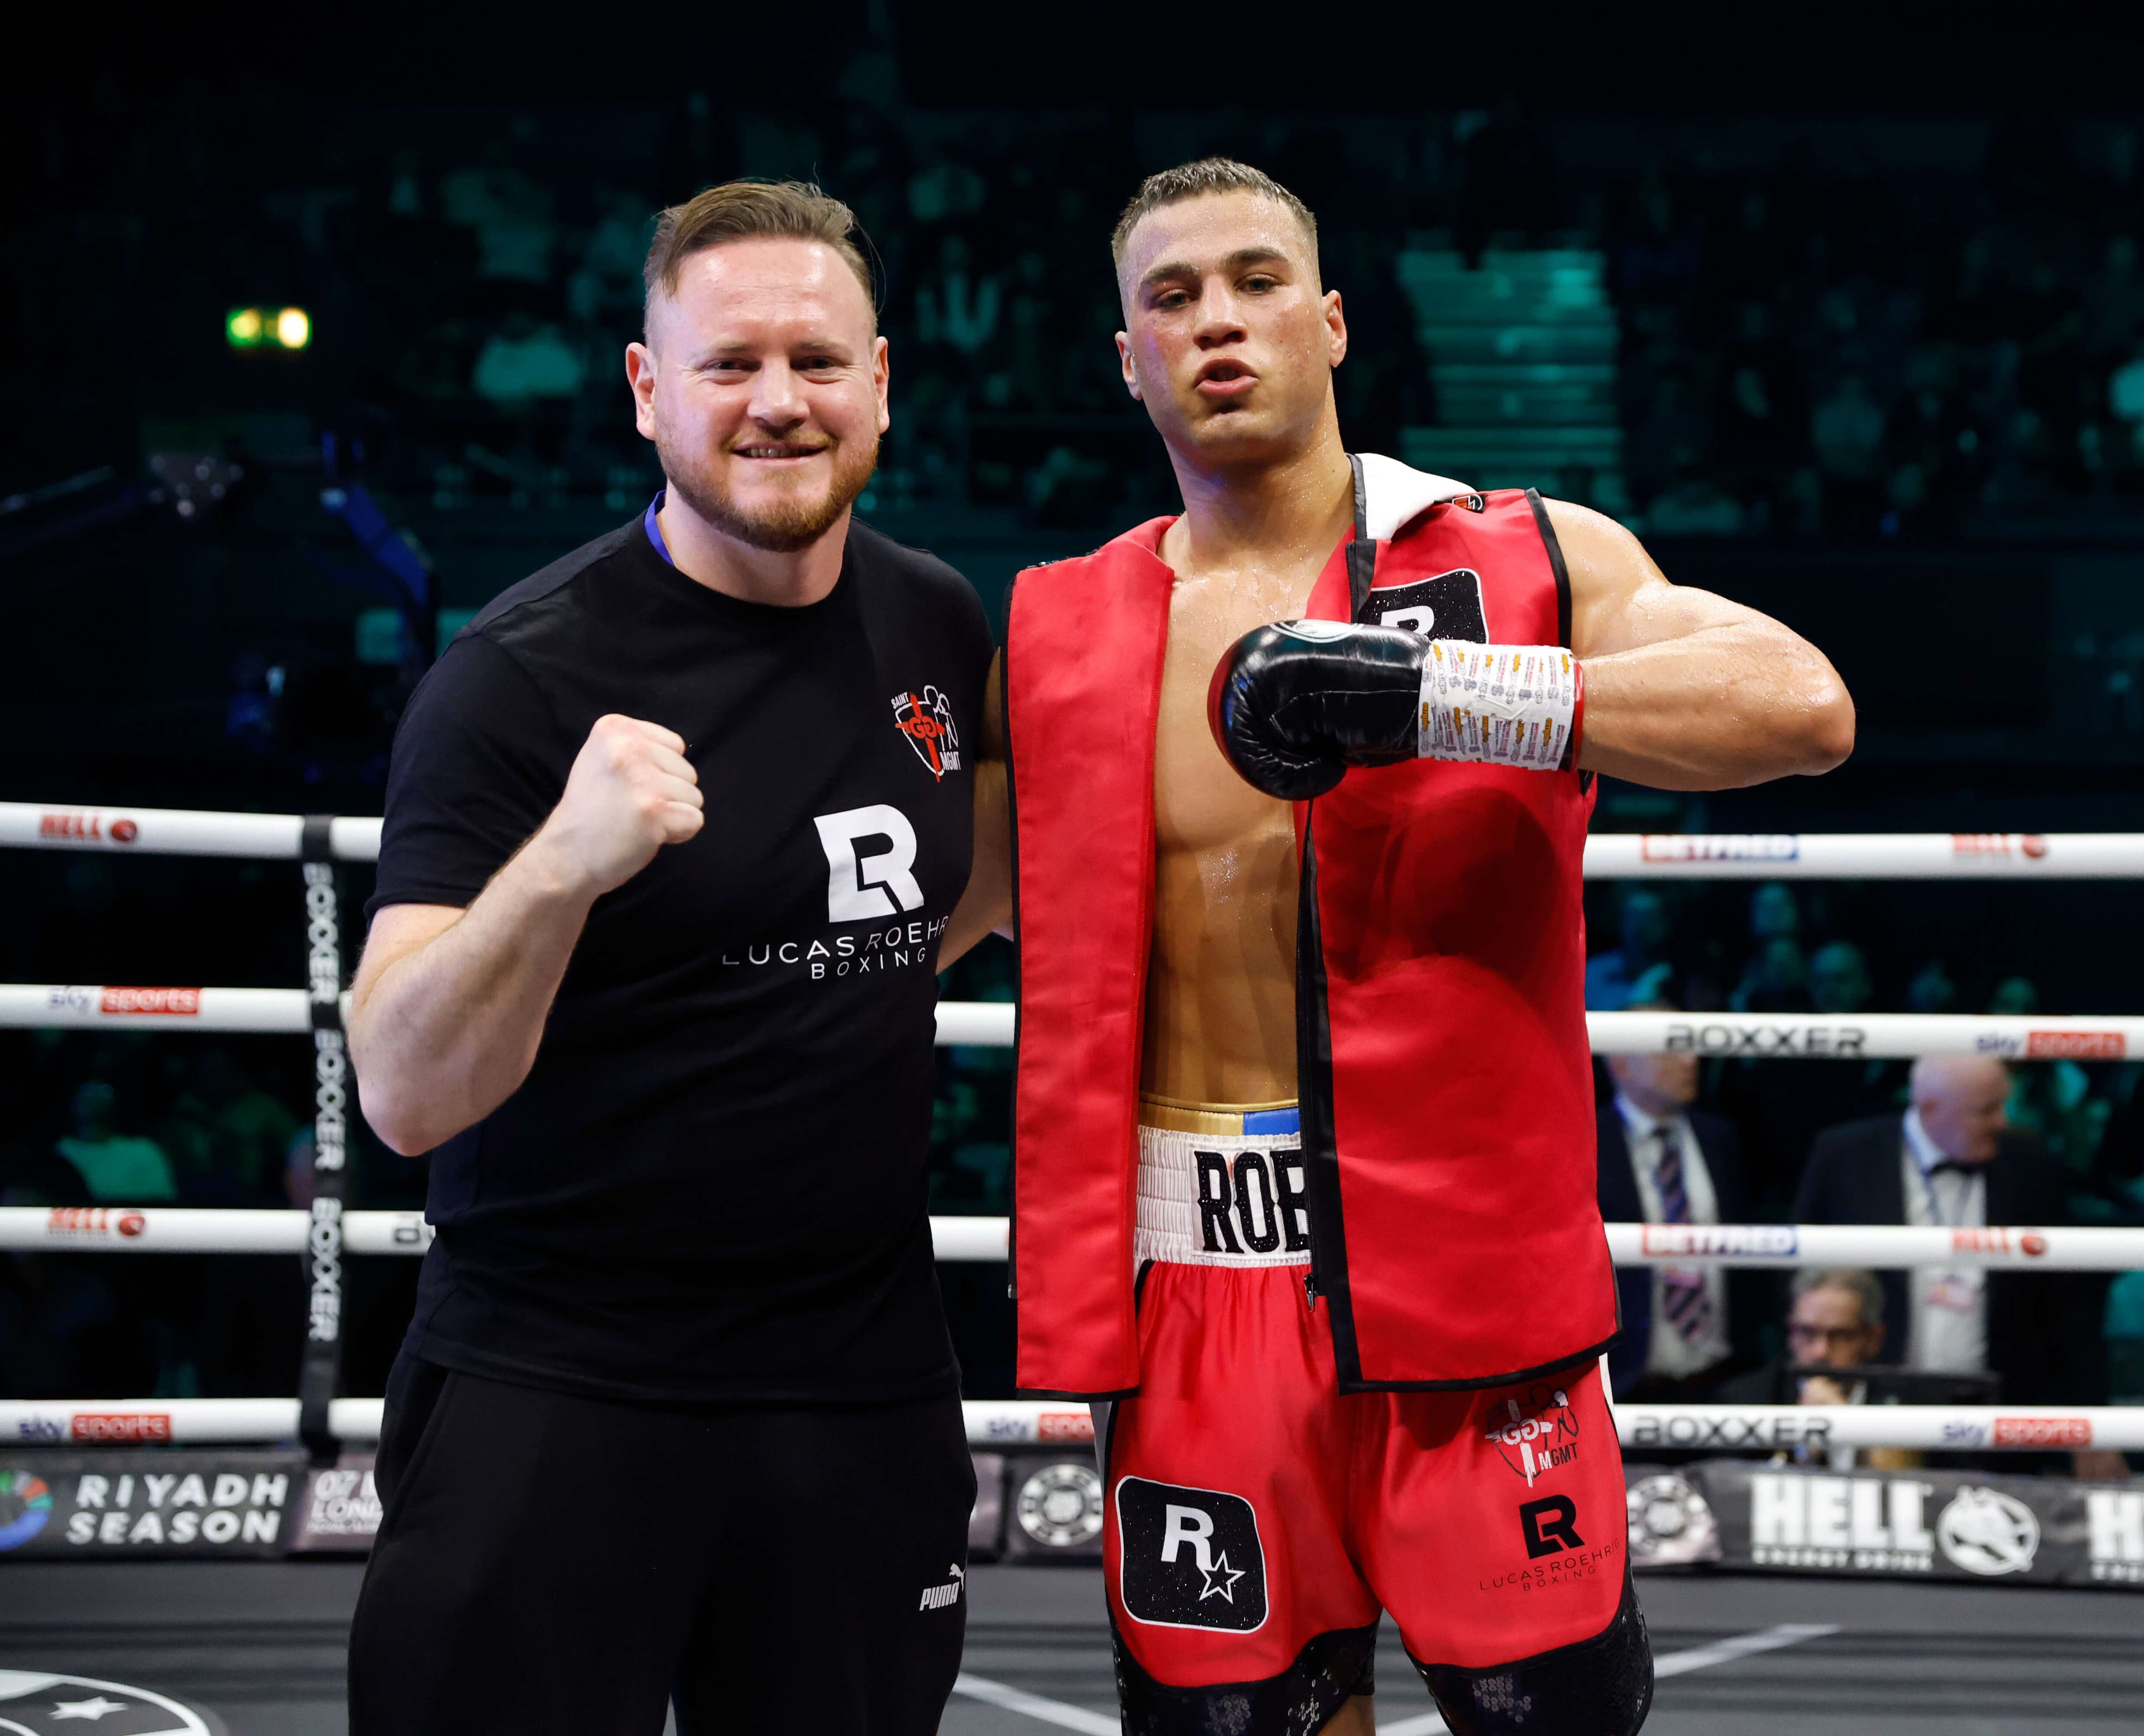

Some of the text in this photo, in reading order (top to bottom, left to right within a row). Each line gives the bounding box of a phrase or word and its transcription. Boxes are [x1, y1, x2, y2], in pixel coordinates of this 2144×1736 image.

[891, 692, 909, 710] SAINT
[940, 751, 961, 771] MGMT
[722, 936, 855, 965] LUCAS
[811, 947, 925, 979] BOXING
[1538, 1443, 1578, 1471] MGMT
[76, 1474, 289, 1509] RIYADH
[1751, 1474, 1935, 1552] HELL
[66, 1511, 281, 1545] SEASON
[1161, 1504, 1213, 1566] R
[1480, 1566, 1544, 1591] LUCAS
[1523, 1566, 1596, 1591] BOXING
[920, 1581, 959, 1611] PUMA
